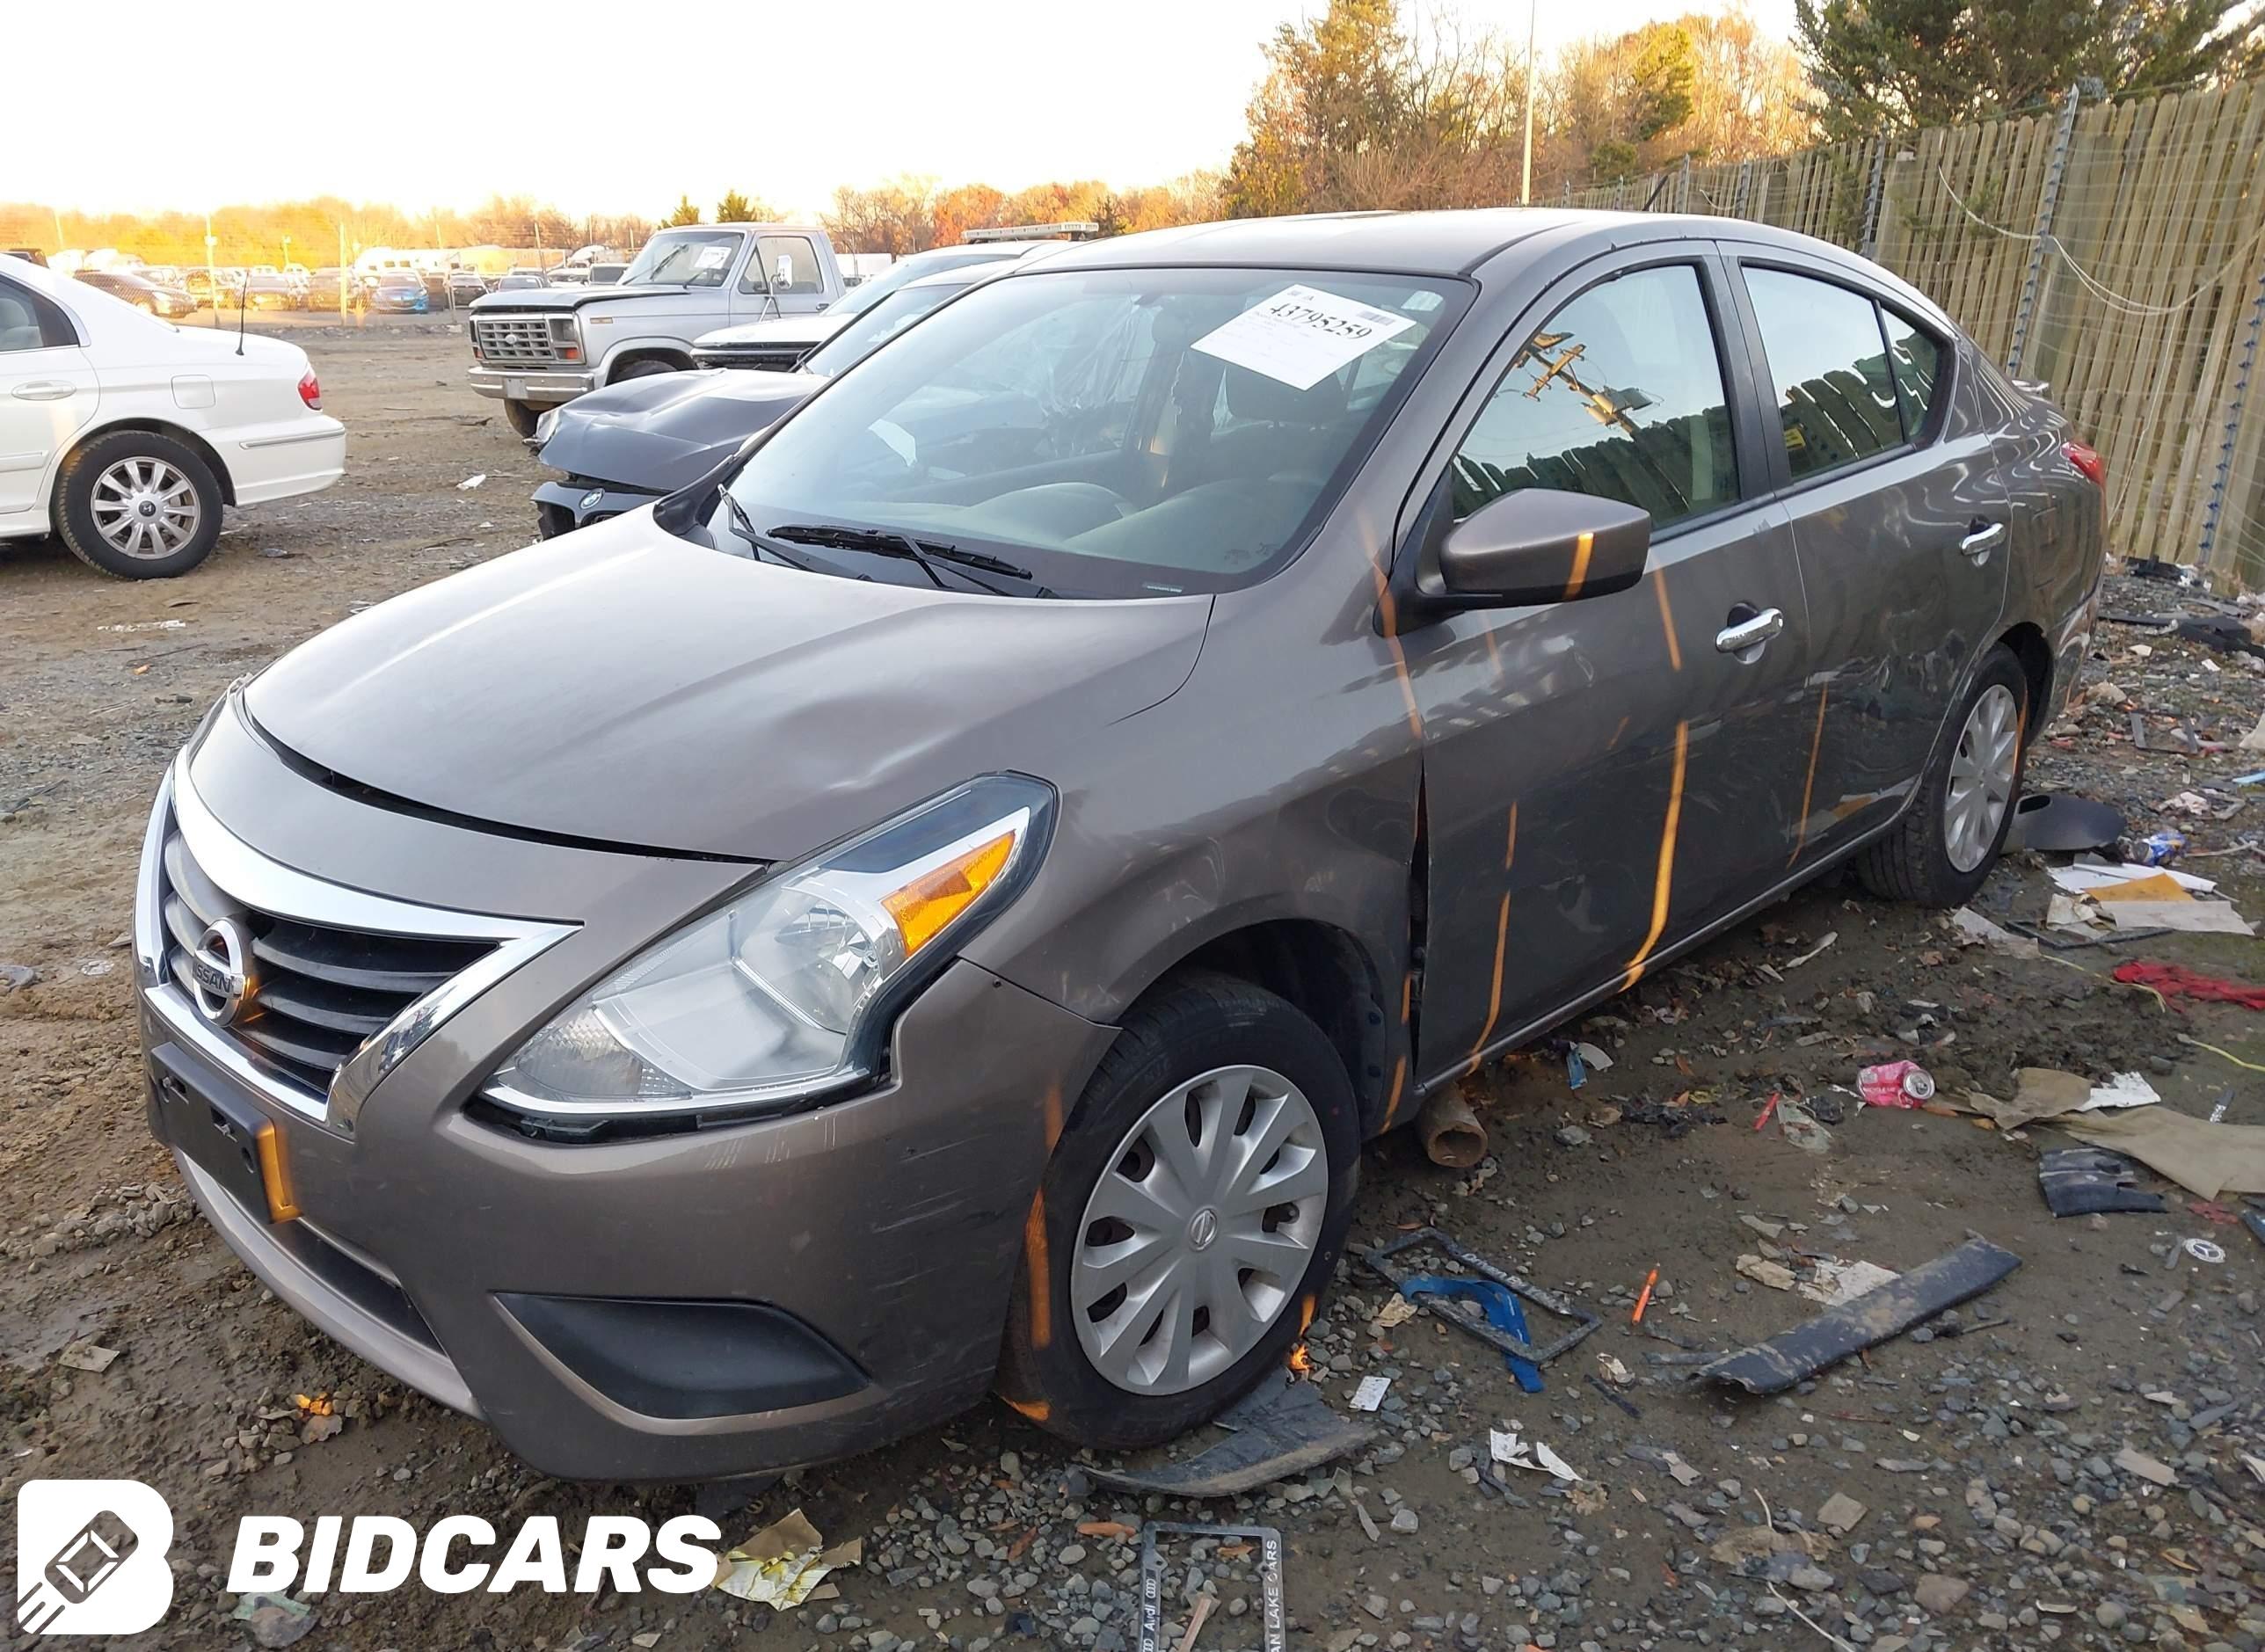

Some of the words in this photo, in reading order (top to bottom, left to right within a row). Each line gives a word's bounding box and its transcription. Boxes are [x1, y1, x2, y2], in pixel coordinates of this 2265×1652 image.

[1269, 302, 1373, 339] 43795259
[1266, 1539, 1278, 1582] CARS
[1144, 1605, 1156, 1631] Audi
[1267, 1587, 1280, 1629] LAKE
